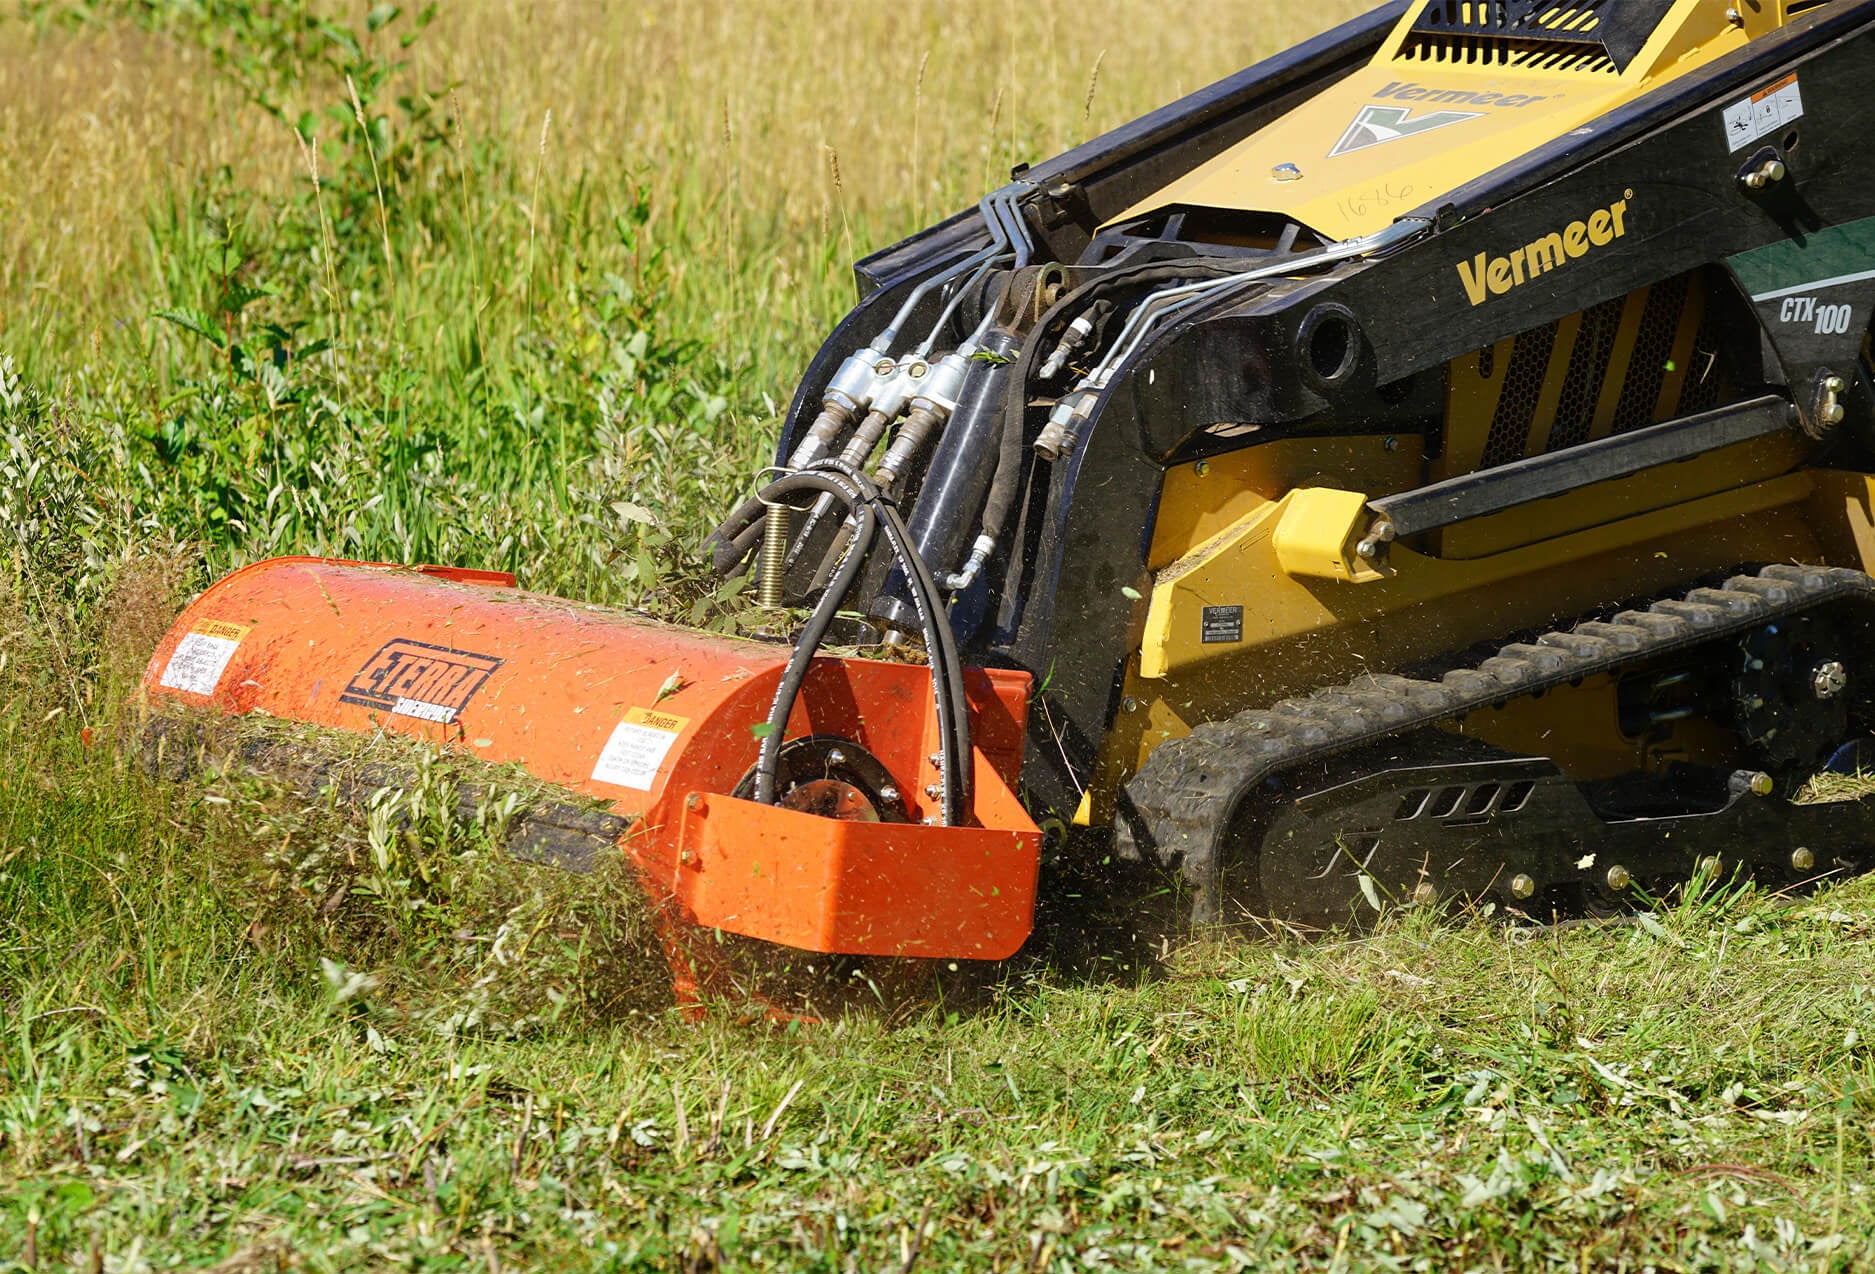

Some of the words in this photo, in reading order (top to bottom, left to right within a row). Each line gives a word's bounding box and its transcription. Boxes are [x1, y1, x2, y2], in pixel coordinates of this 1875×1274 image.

[1372, 82, 1547, 107] Vermeer
[1456, 199, 1627, 306] Vermeer
[1780, 297, 1817, 322] CTX
[1814, 304, 1852, 334] 100
[208, 624, 241, 641] DANGER
[351, 651, 489, 708] ETERRA
